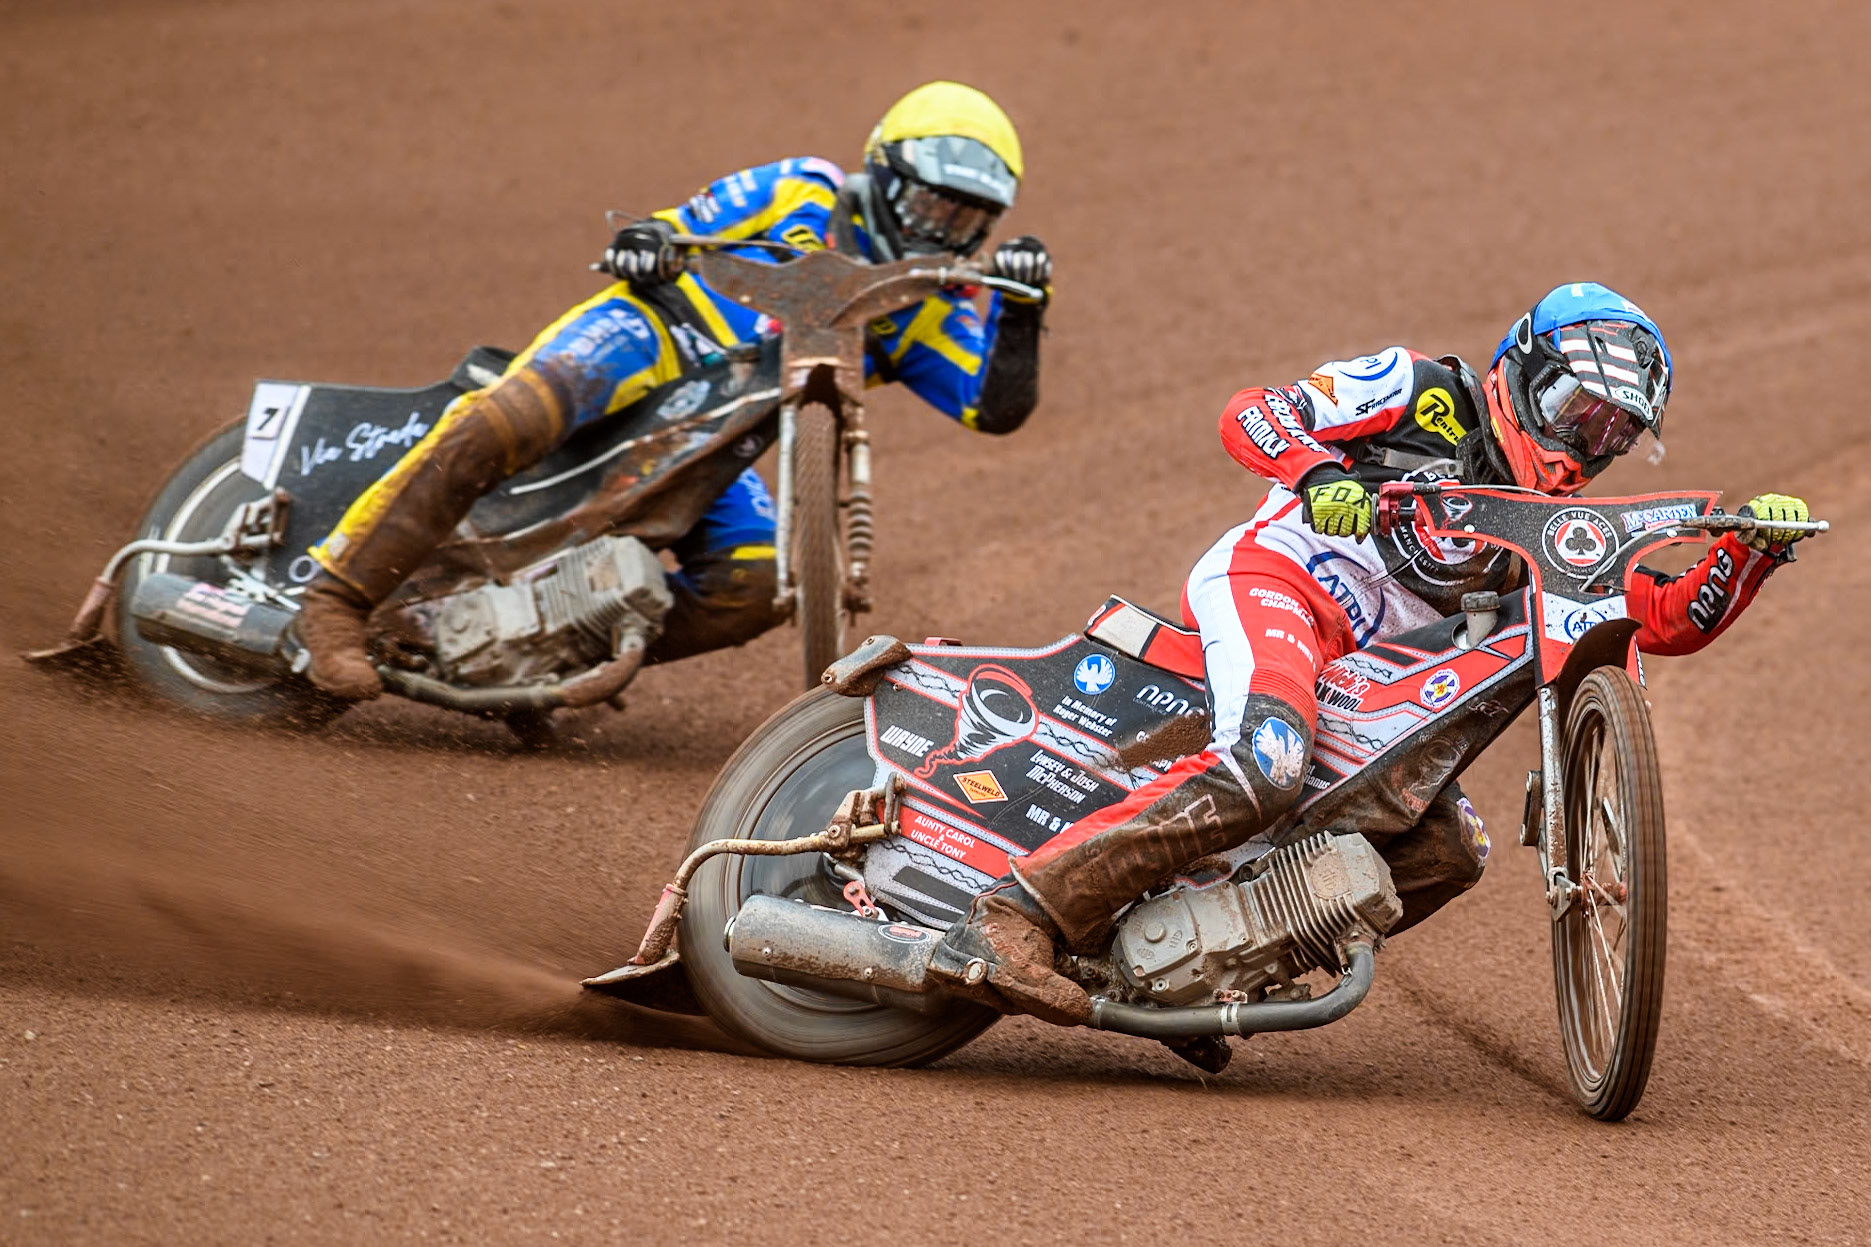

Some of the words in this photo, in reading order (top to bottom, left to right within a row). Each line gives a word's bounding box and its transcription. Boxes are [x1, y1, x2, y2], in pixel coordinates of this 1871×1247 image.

[257, 407, 279, 430] 7
[1236, 405, 1291, 459] FAMILY
[1312, 486, 1367, 510] FOX
[1547, 513, 1569, 537] BELLE
[1571, 511, 1592, 521] VUE
[1593, 517, 1613, 538] ACES
[1249, 587, 1300, 608] GORDON
[1265, 628, 1286, 640] MR
[1053, 704, 1080, 722] Roger
[1078, 715, 1114, 738] Webster
[1061, 695, 1073, 706] In
[1070, 699, 1107, 724] Memory
[1104, 717, 1118, 727] of
[880, 725, 935, 758] WAYNE
[1060, 768, 1074, 779] &
[962, 777, 1001, 798] STEELWELD
[1026, 804, 1050, 827] MR
[1048, 817, 1062, 832] &
[910, 829, 941, 849] UNCLE
[940, 842, 967, 860] TONY
[914, 815, 946, 834] AUNTY
[945, 829, 976, 849] CAROL
[938, 834, 945, 842] &
